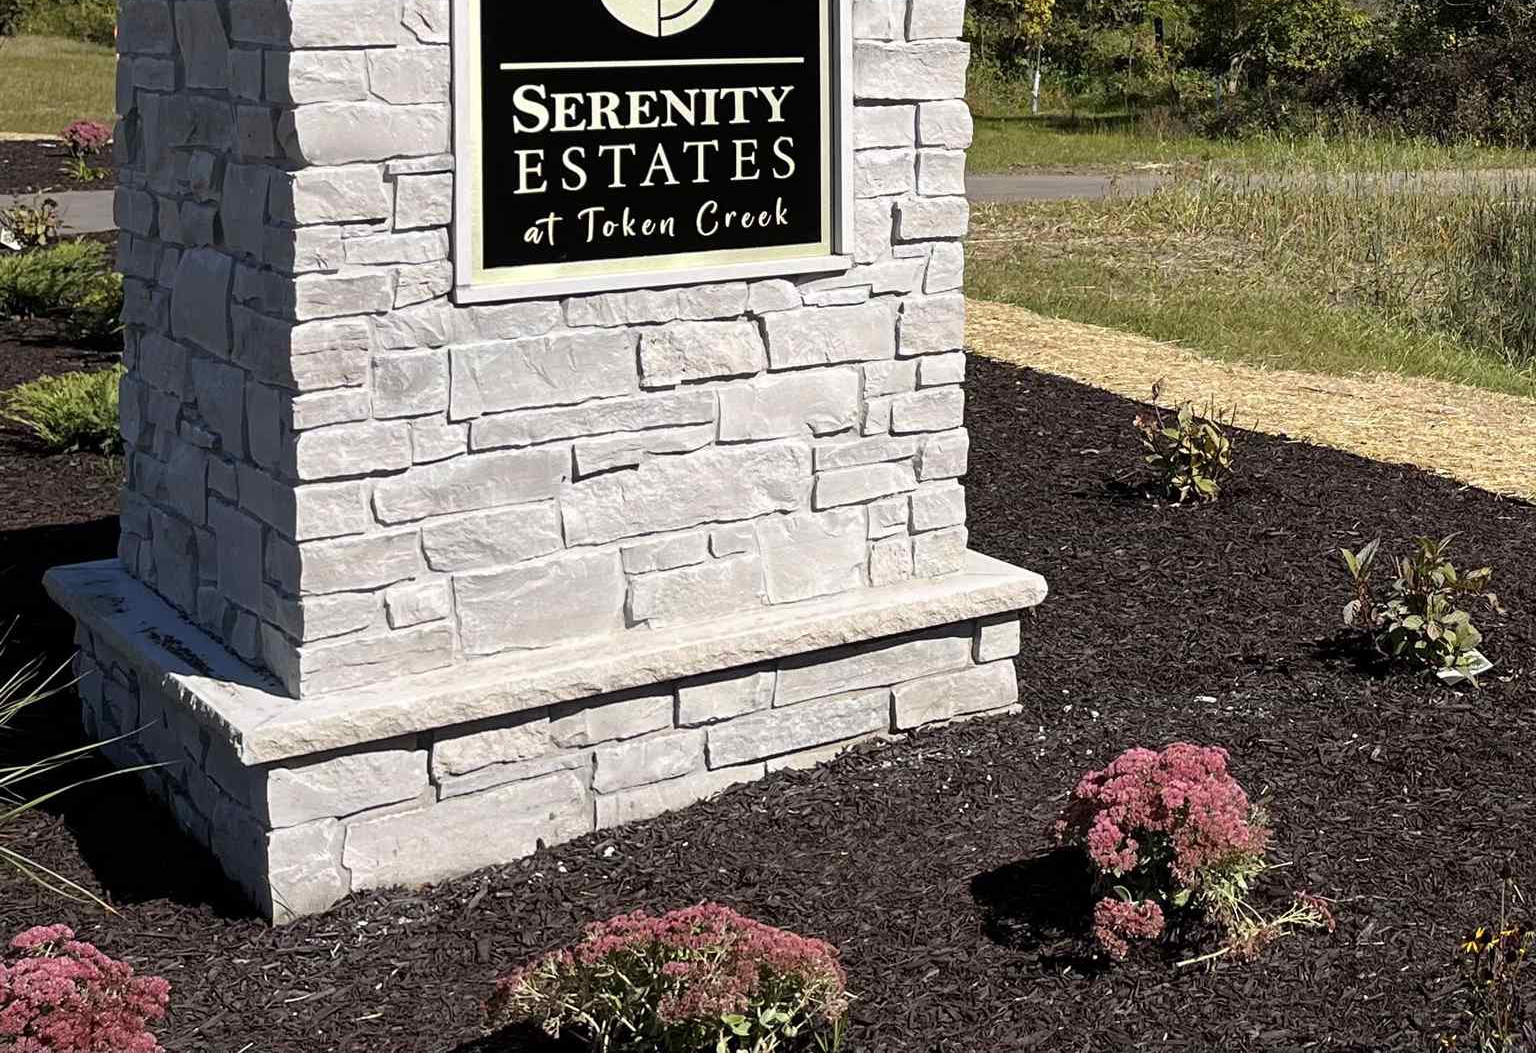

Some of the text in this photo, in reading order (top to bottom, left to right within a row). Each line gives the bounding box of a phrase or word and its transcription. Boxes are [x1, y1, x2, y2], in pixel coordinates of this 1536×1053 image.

[512, 83, 795, 134] SERENITY
[513, 135, 796, 195] ESTATES
[523, 196, 788, 246] at Token Creek
